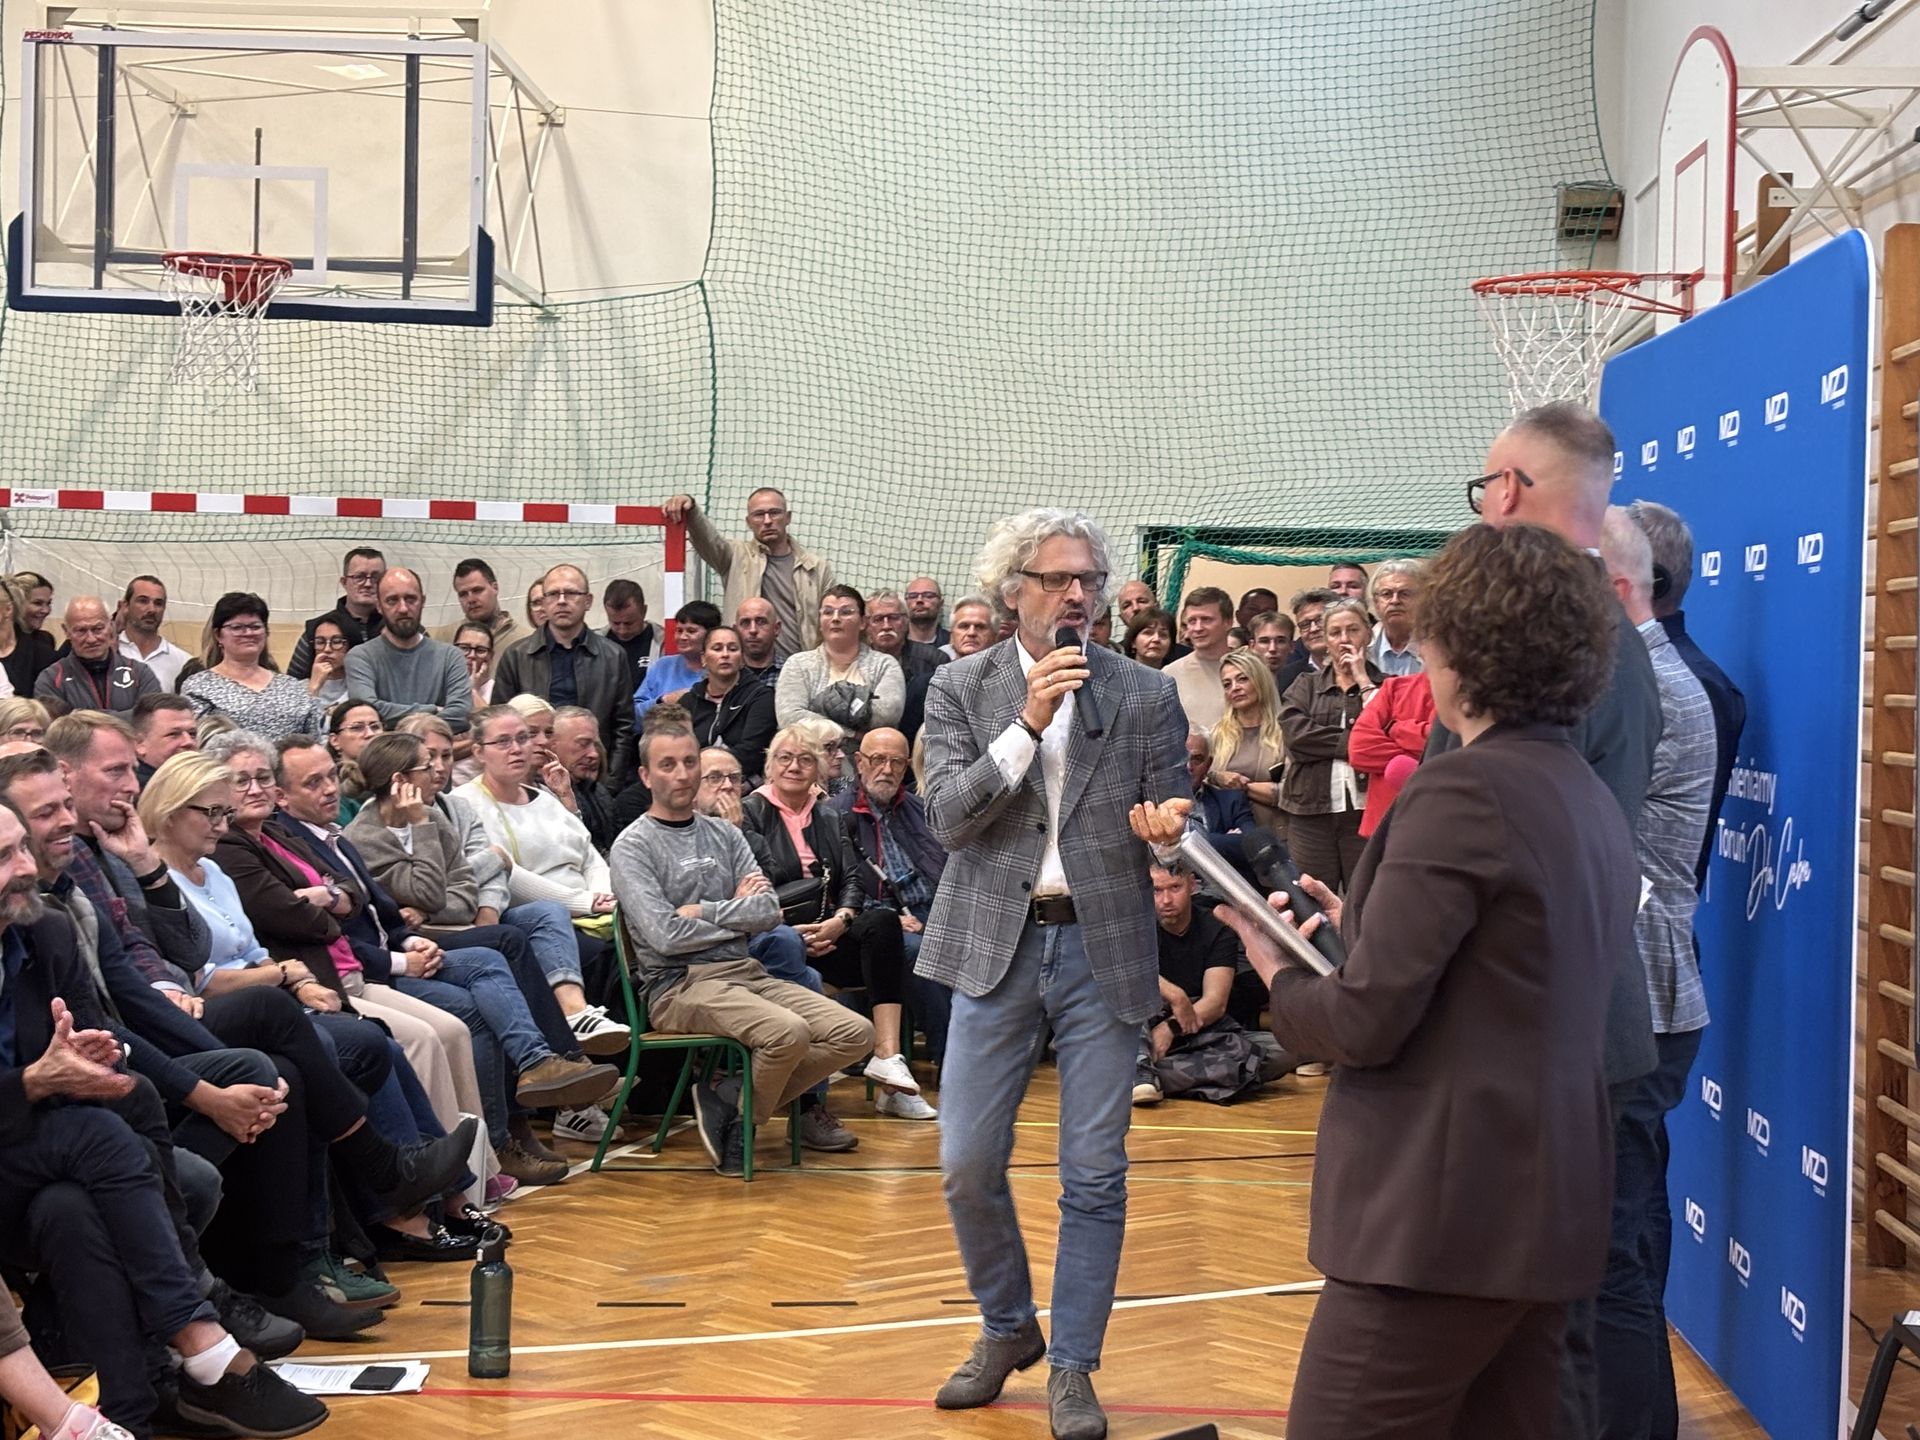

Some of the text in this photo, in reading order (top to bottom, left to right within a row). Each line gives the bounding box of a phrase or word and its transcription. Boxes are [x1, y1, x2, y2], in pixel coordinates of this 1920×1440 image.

[1820, 364, 1849, 405] MZD
[1718, 410, 1741, 441] MZD
[1764, 391, 1789, 426] MZD
[1641, 439, 1659, 466] MZD
[1676, 425, 1696, 454] MZD
[1700, 550, 1722, 578] MZD
[1744, 543, 1768, 572] MZD
[1797, 532, 1824, 565] MZD
[1701, 1075, 1723, 1112] MZD
[1747, 1107, 1770, 1147] MZD
[1801, 1145, 1829, 1187] MZD
[1685, 1197, 1706, 1236] MZD
[1728, 1237, 1751, 1279] MZD
[1781, 1285, 1807, 1332] MZD
